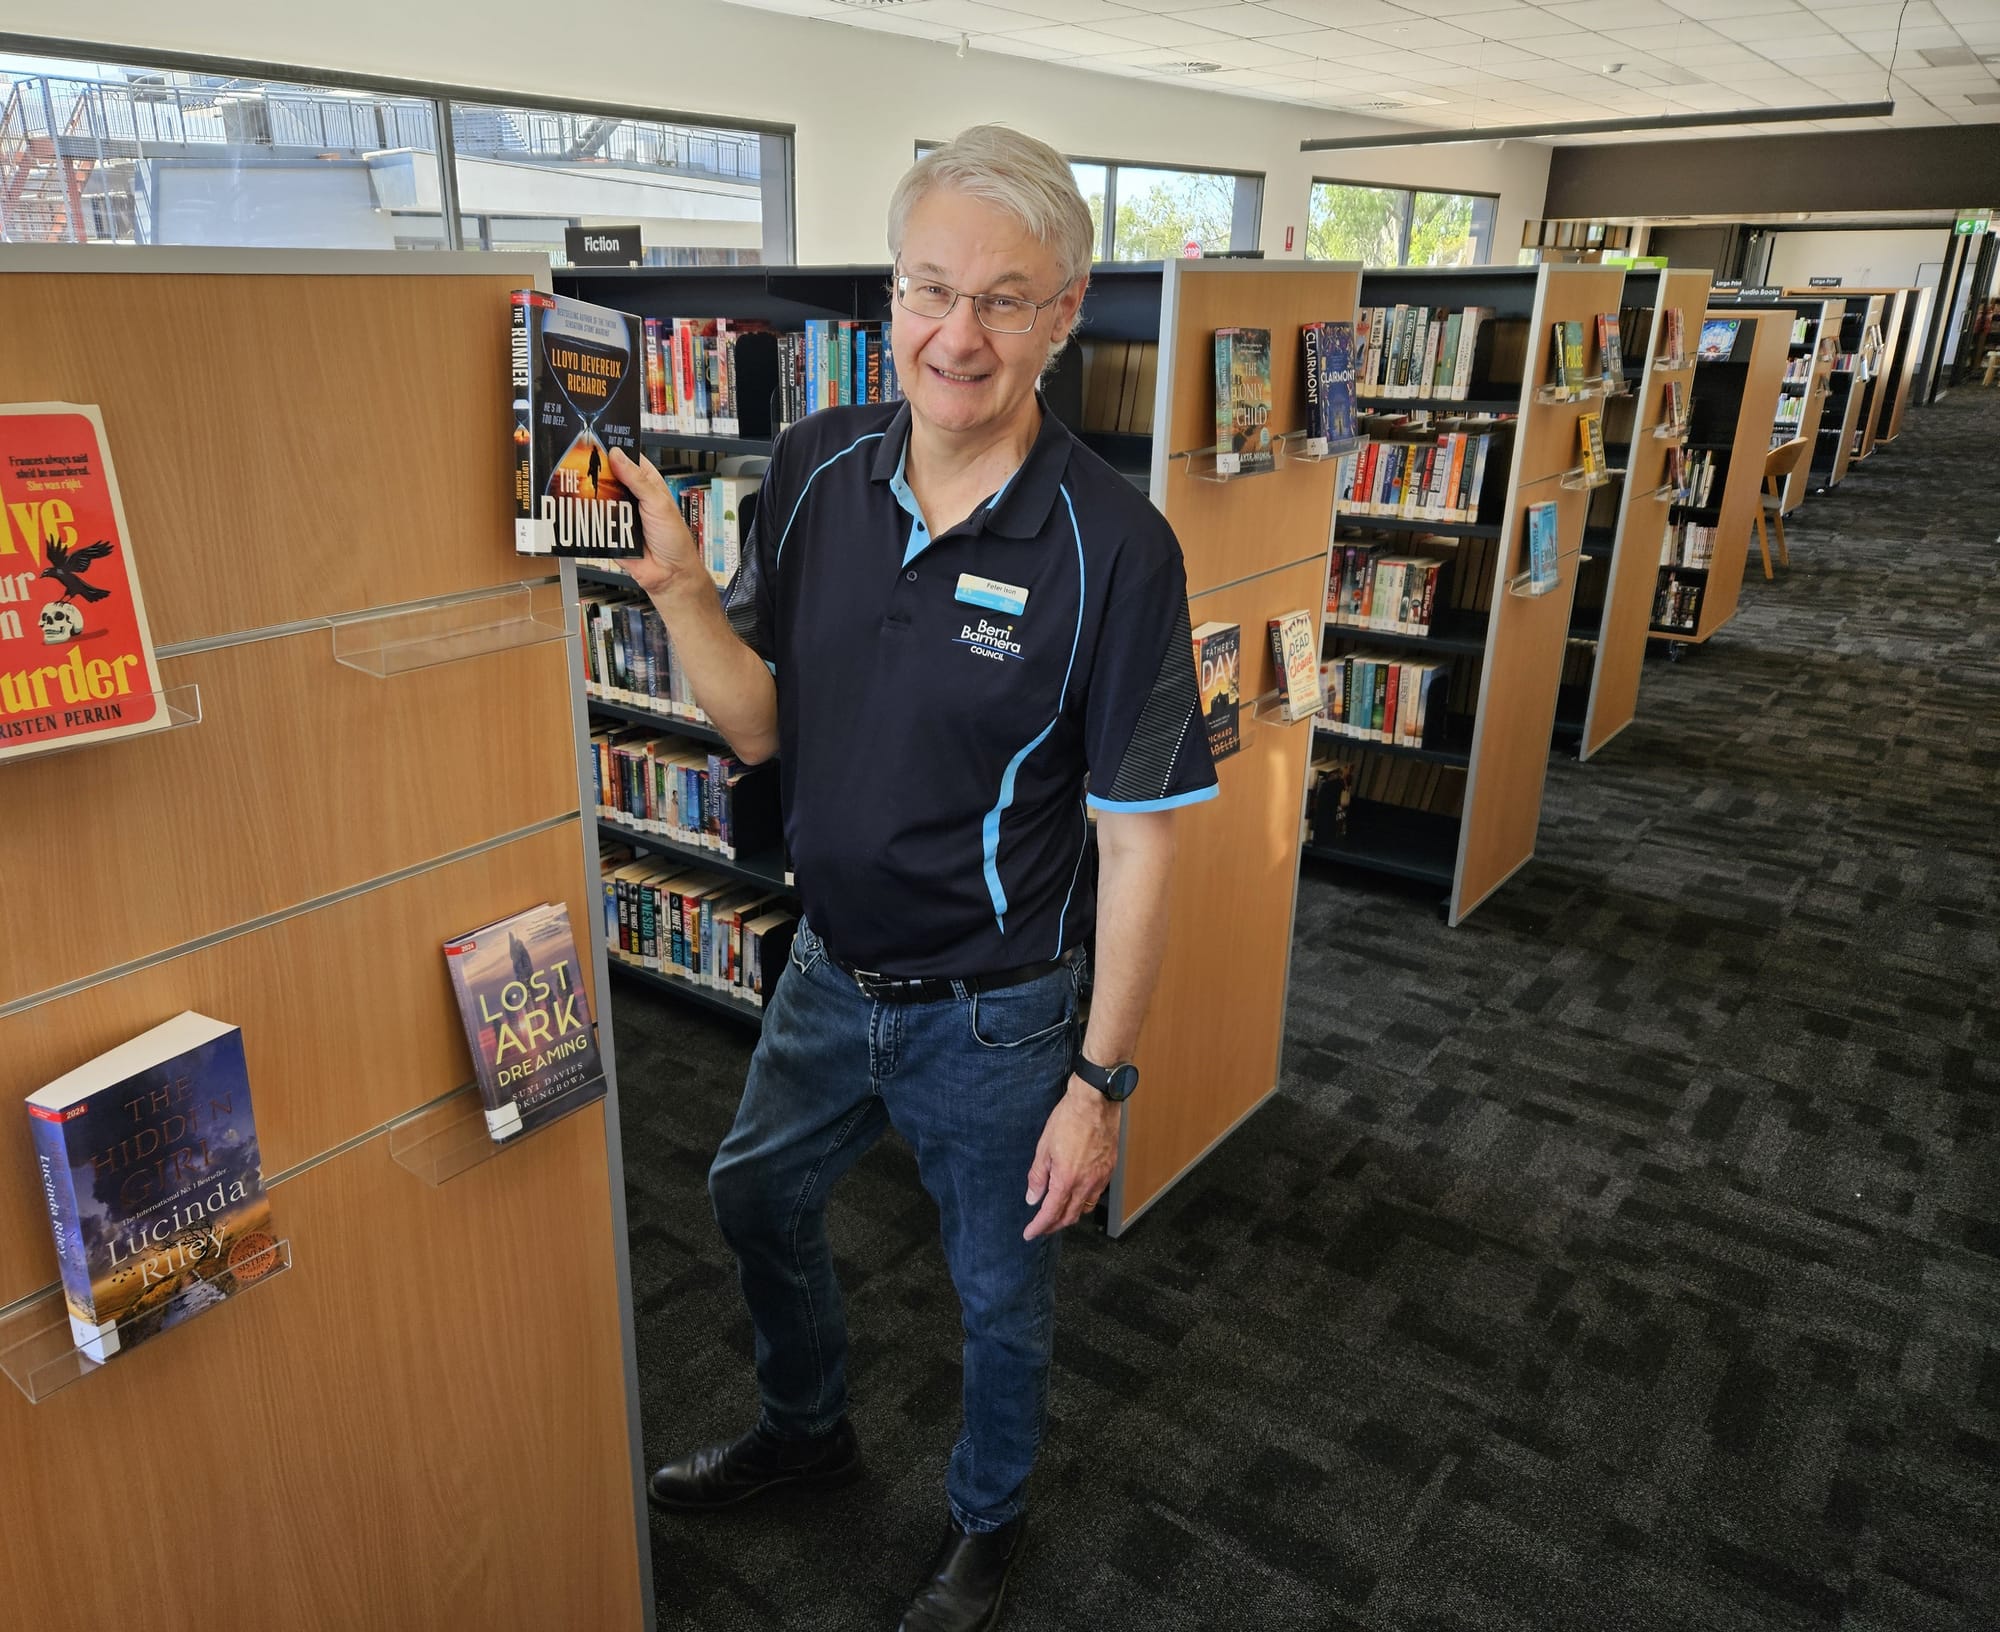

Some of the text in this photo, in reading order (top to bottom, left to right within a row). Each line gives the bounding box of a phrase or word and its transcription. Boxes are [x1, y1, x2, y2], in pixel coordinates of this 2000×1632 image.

[584, 236, 620, 252] Fiction
[513, 307, 524, 324] THE
[542, 299, 554, 308] 2024
[511, 328, 529, 387] RUNNER
[647, 336, 657, 371] FURY
[1402, 335, 1411, 360] CROSSING
[551, 348, 621, 378] LLOYD DEVEREUX
[1245, 362, 1258, 377] THE
[1305, 332, 1317, 404] CLAIRMONT
[567, 373, 607, 397] RICHARDS
[868, 353, 879, 404] VINE ST
[1320, 369, 1355, 383] CLAIRMONT
[1238, 383, 1263, 401] ONLY
[542, 414, 551, 424] TOO
[543, 402, 561, 413] HE'S IN
[1236, 407, 1268, 426] CHILD
[614, 425, 631, 435] ALMOST
[72, 453, 88, 463] said
[1240, 452, 1253, 464] AYTE
[26, 480, 44, 491] She
[44, 481, 60, 490] was
[560, 468, 580, 494] THE
[692, 493, 698, 505] NO
[541, 495, 635, 549] RUNNER
[1328, 586, 1337, 607] FIRE
[960, 625, 1021, 654] Barmera
[977, 619, 1013, 640] Berri
[970, 645, 1005, 661] COUNCIL
[1206, 639, 1235, 658] FATHER'S
[1273, 632, 1281, 652] DEAD
[1290, 632, 1310, 656] DEAD
[0, 645, 138, 715] urder
[1202, 648, 1238, 692] DAY
[64, 704, 122, 727] PERRIN
[712, 759, 721, 818] Annie Murray
[641, 888, 653, 902] JO
[683, 901, 691, 912] JO
[619, 901, 628, 924] MACBETH
[642, 904, 655, 938] NESBO
[671, 909, 682, 964] KNIFE JO NESBO
[480, 960, 568, 1023] LOST
[496, 994, 582, 1065] ARK
[498, 1034, 588, 1087] DREAMING
[512, 1062, 584, 1101] SUYI DAVIES
[124, 1076, 193, 1122] THE
[66, 1105, 85, 1119] 2024
[40, 1154, 58, 1216] Lucinda
[52, 1214, 67, 1260] Riley
[122, 1211, 136, 1226] The
[136, 1189, 181, 1219] International
[106, 1178, 248, 1268] Lucinda
[141, 1225, 230, 1290] Riley
